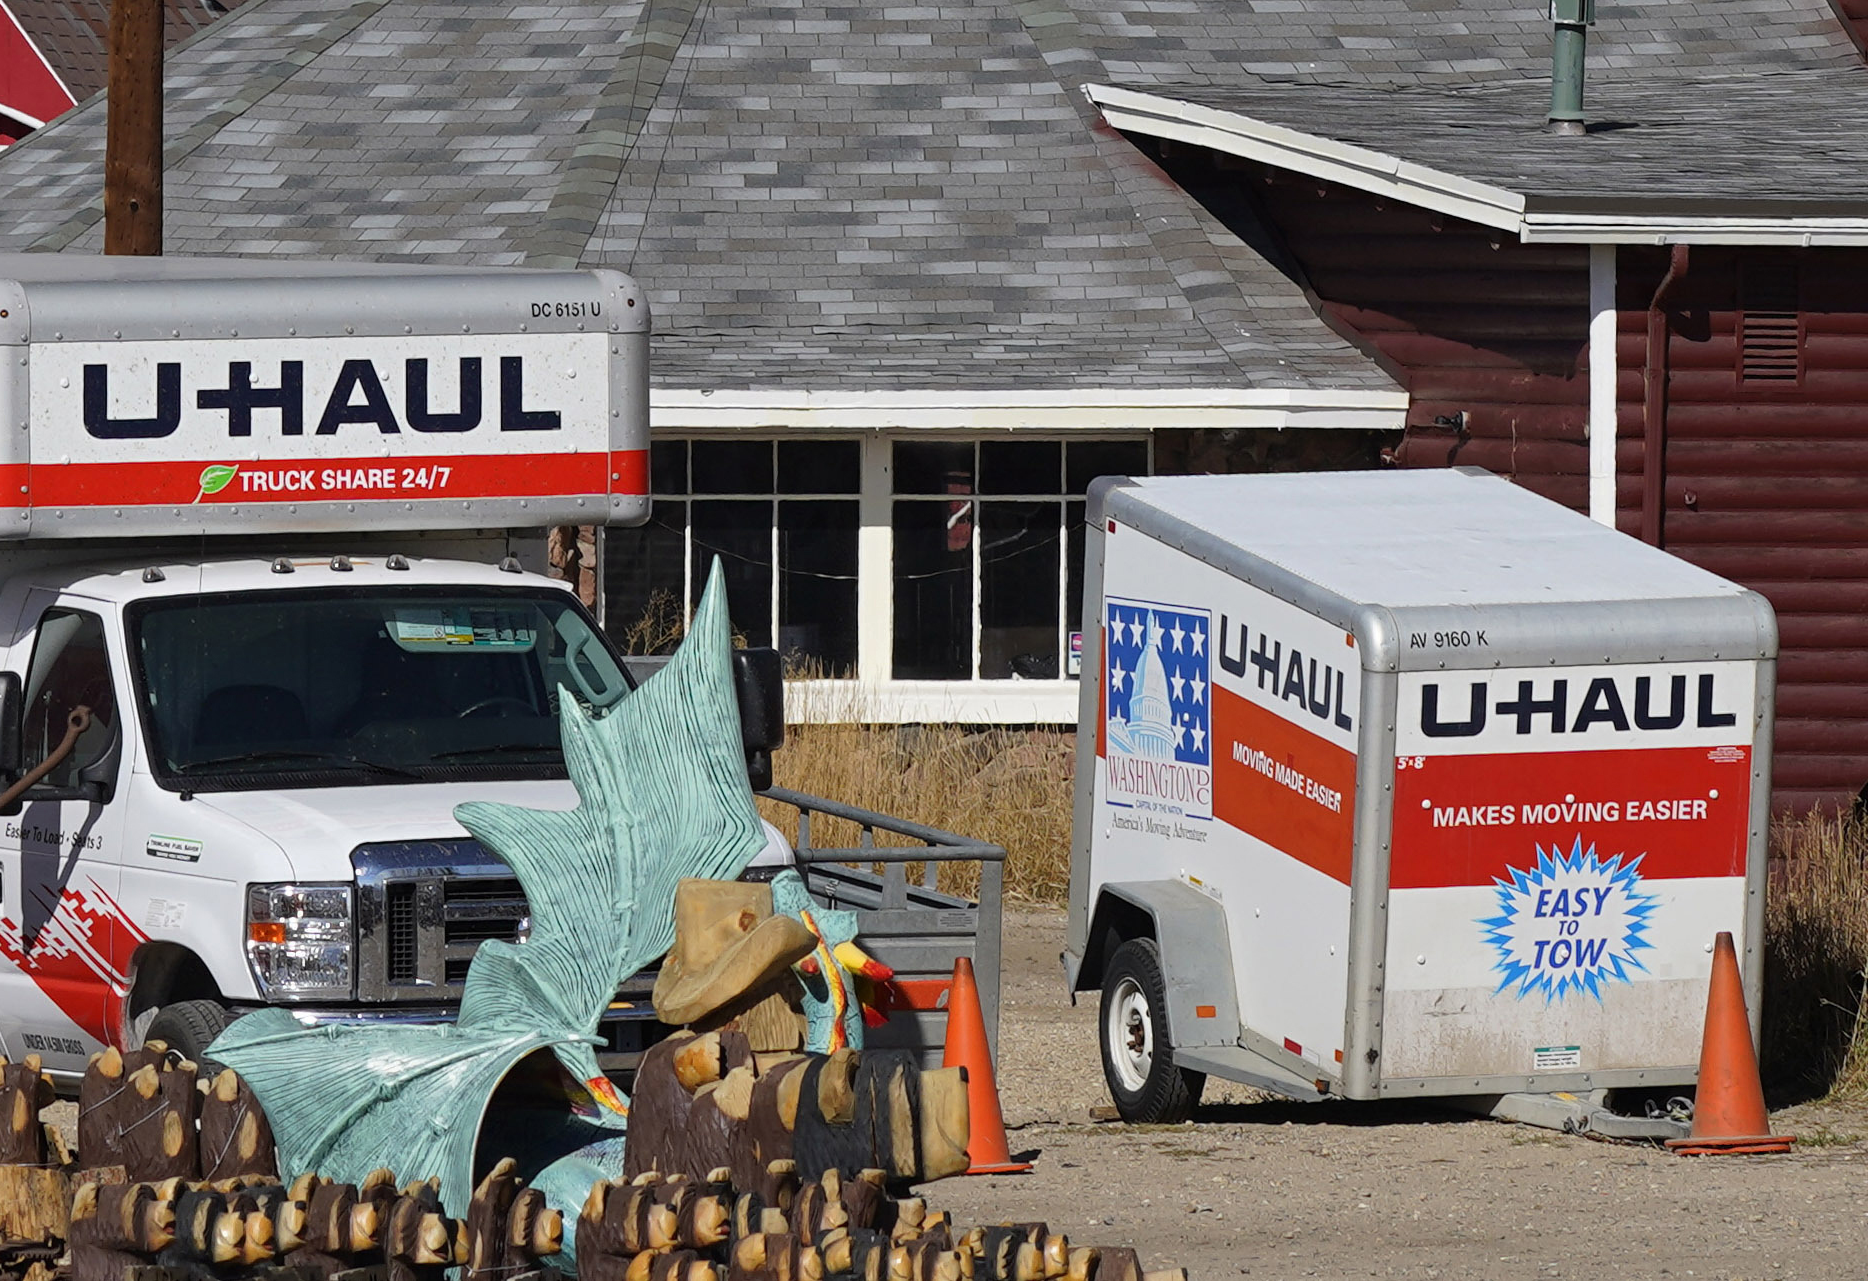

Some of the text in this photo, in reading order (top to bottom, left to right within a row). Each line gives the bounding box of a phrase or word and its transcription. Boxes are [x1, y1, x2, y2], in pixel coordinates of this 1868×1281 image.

[531, 300, 601, 318] DC 6151 U
[83, 356, 562, 440] U-HAUL
[238, 465, 452, 492] TRUCK SHARE 24/7
[1410, 630, 1489, 650] AV 9160 K
[1219, 613, 1352, 733] U-HAUL
[1421, 673, 1736, 738] U-HAUL
[1108, 754, 1196, 804] WASHINGTON
[1232, 740, 1343, 814] MOVING MADE EASIER
[1112, 812, 1208, 843] America's Moving Adventure
[1433, 799, 1708, 828] MAKES MOVING EASIER
[5, 822, 31, 840] Easier
[33, 826, 42, 843] To
[44, 827, 66, 846] Load
[96, 835, 103, 850] 3
[1534, 886, 1613, 919] EASY
[1558, 920, 1579, 936] TO
[1534, 938, 1608, 969] TOW
